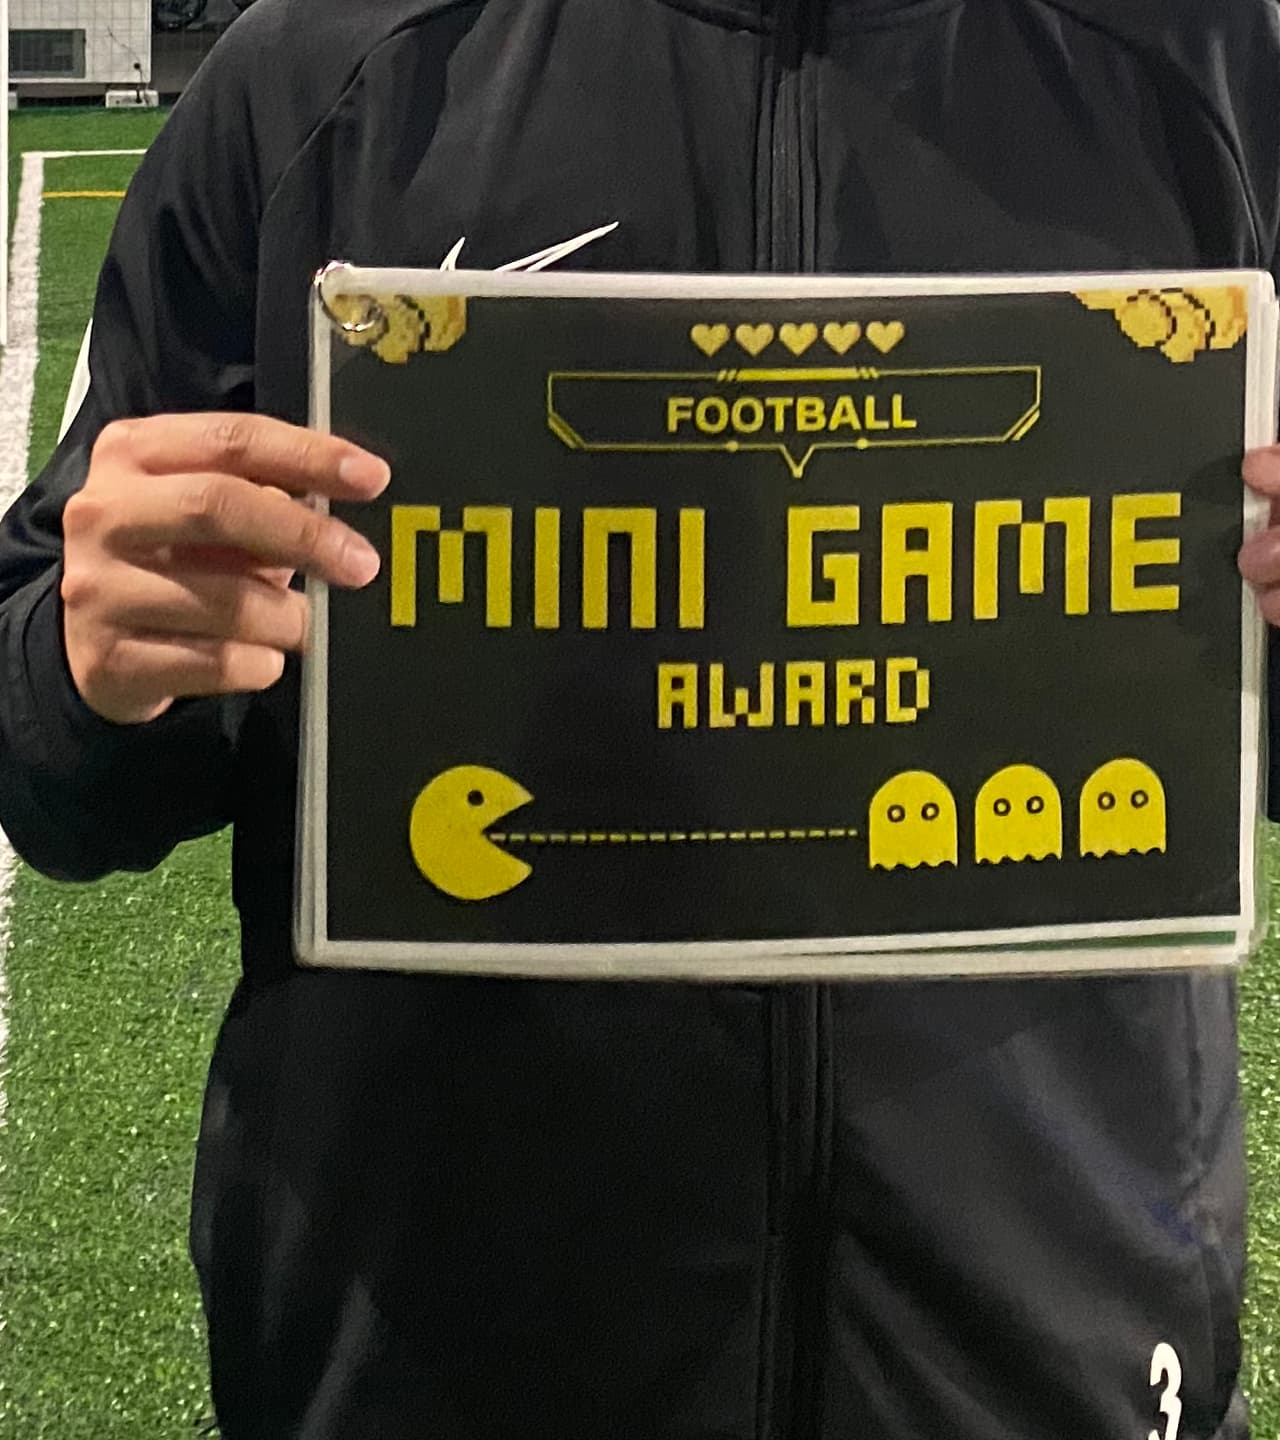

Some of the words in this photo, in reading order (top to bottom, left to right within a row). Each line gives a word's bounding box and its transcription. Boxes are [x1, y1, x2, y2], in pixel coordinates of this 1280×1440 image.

[667, 393, 918, 435] FOOTBALL
[389, 503, 706, 630] MINI
[785, 491, 1183, 628] GAME
[657, 656, 931, 729] AWARD
[1148, 1342, 1183, 1440] 3
